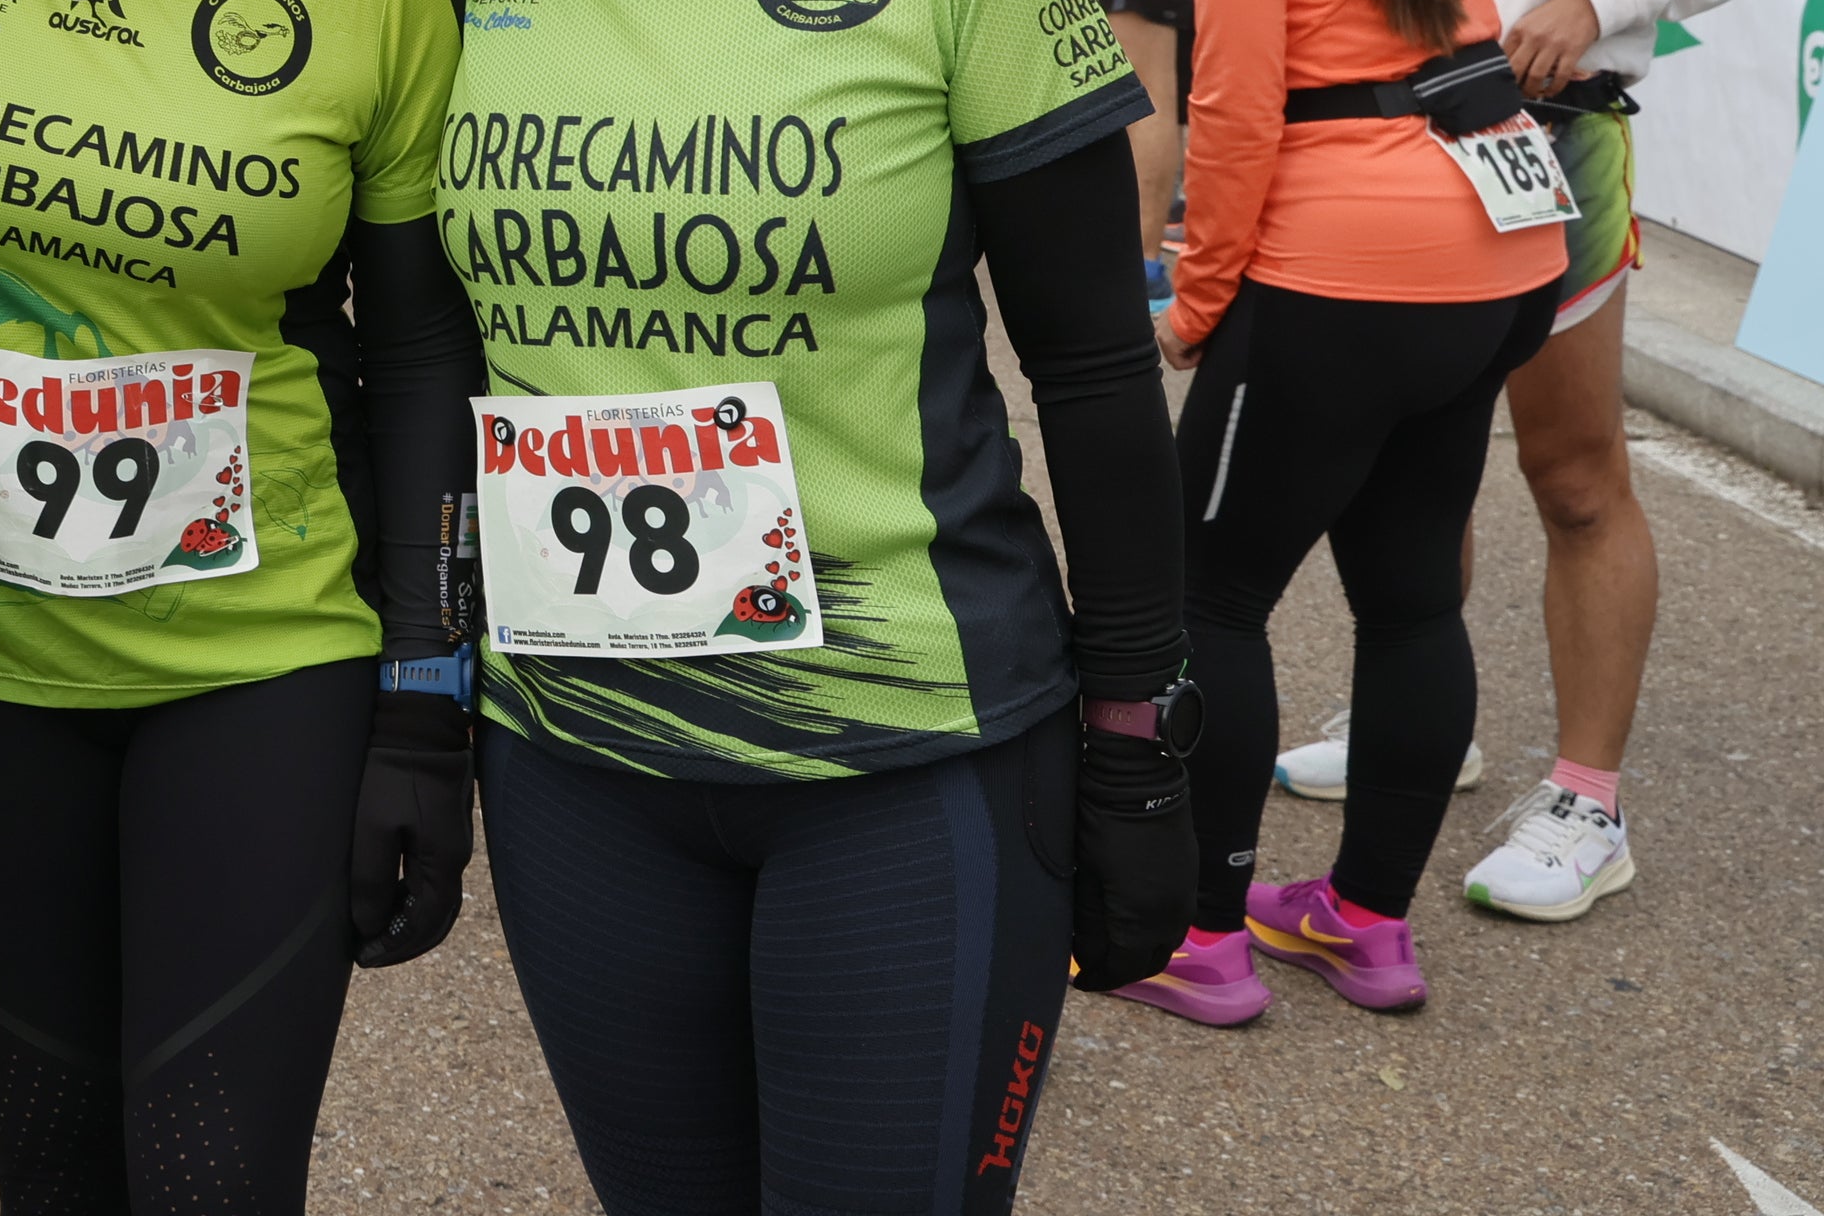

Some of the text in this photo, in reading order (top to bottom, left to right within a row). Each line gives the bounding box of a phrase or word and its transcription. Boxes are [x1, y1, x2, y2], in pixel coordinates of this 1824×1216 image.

[776, 4, 843, 25] CARBAJOSA
[1054, 18, 1116, 67] CARB
[1070, 48, 1128, 88] SALA
[214, 66, 281, 95] Carbajosa
[439, 111, 847, 198] CORRECAMINOS
[1476, 134, 1551, 196] 185
[441, 208, 836, 296] CARBAJOSA
[474, 298, 819, 359] SALAMANCA
[68, 361, 167, 384] FLORISTERÍAS
[586, 404, 684, 422] FLORISTERÍAS
[481, 405, 781, 477] bedunia
[16, 437, 161, 541] 99
[551, 484, 700, 596] 98
[513, 629, 566, 639] www.bedunia.com
